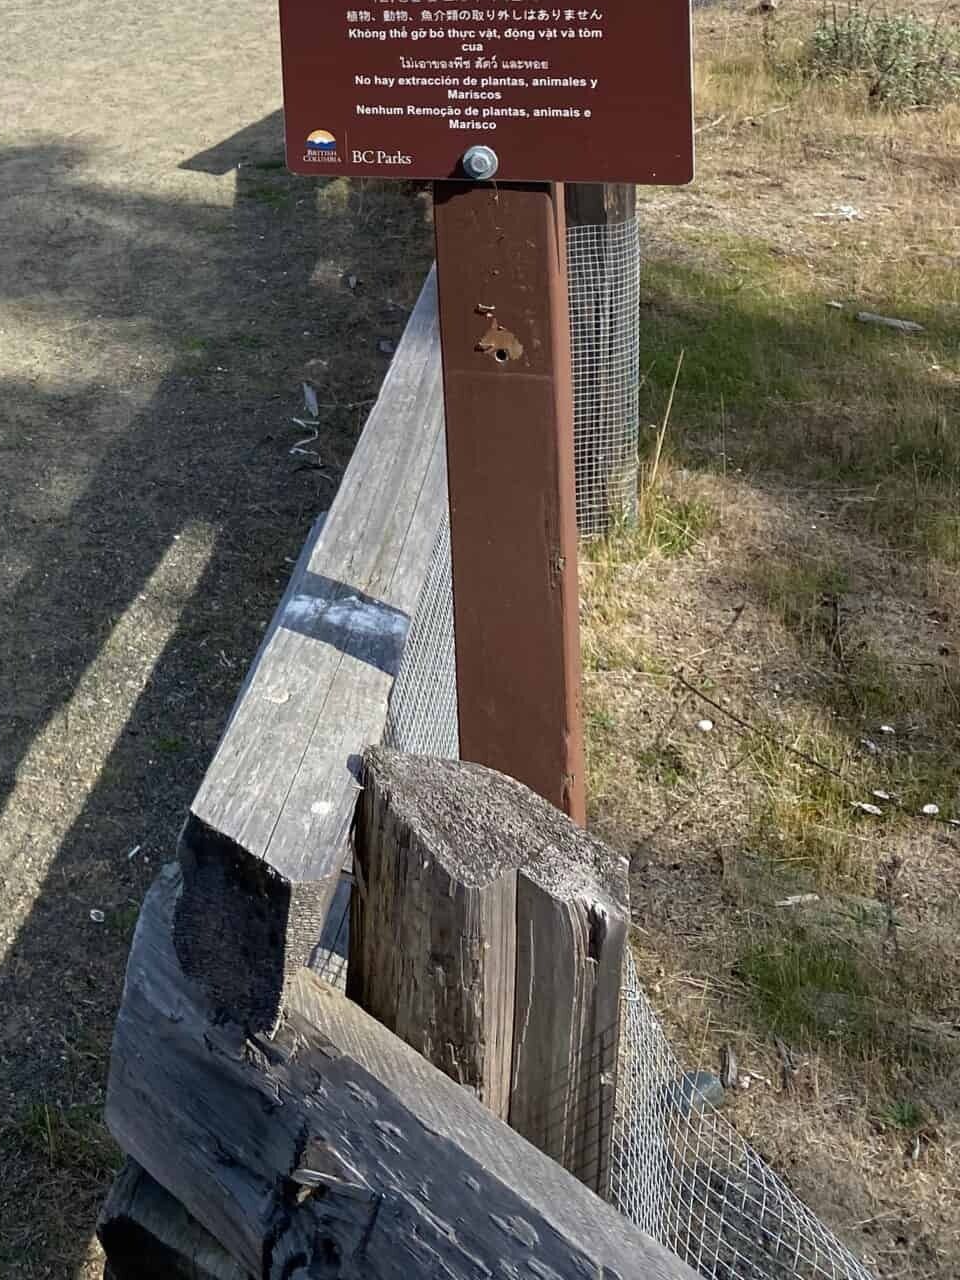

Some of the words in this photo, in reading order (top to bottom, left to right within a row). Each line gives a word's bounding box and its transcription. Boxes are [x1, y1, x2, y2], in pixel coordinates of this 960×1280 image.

[560, 29, 575, 38] và
[461, 43, 484, 52] cua
[355, 75, 371, 85] No
[374, 76, 395, 88] hay
[398, 76, 460, 86] extracción
[463, 76, 478, 86] de
[481, 76, 529, 89] plantas,
[532, 76, 587, 87] animales
[590, 79, 598, 89] y
[448, 89, 502, 100] Mariscos
[356, 105, 404, 116] Nenhum
[407, 105, 462, 118] Remoção
[465, 107, 479, 116] de
[482, 107, 530, 119] plantas,
[533, 107, 581, 118] animais
[584, 110, 592, 118] e
[449, 120, 497, 130] Marisco
[352, 150, 375, 164] BC
[377, 150, 412, 165] Parks
